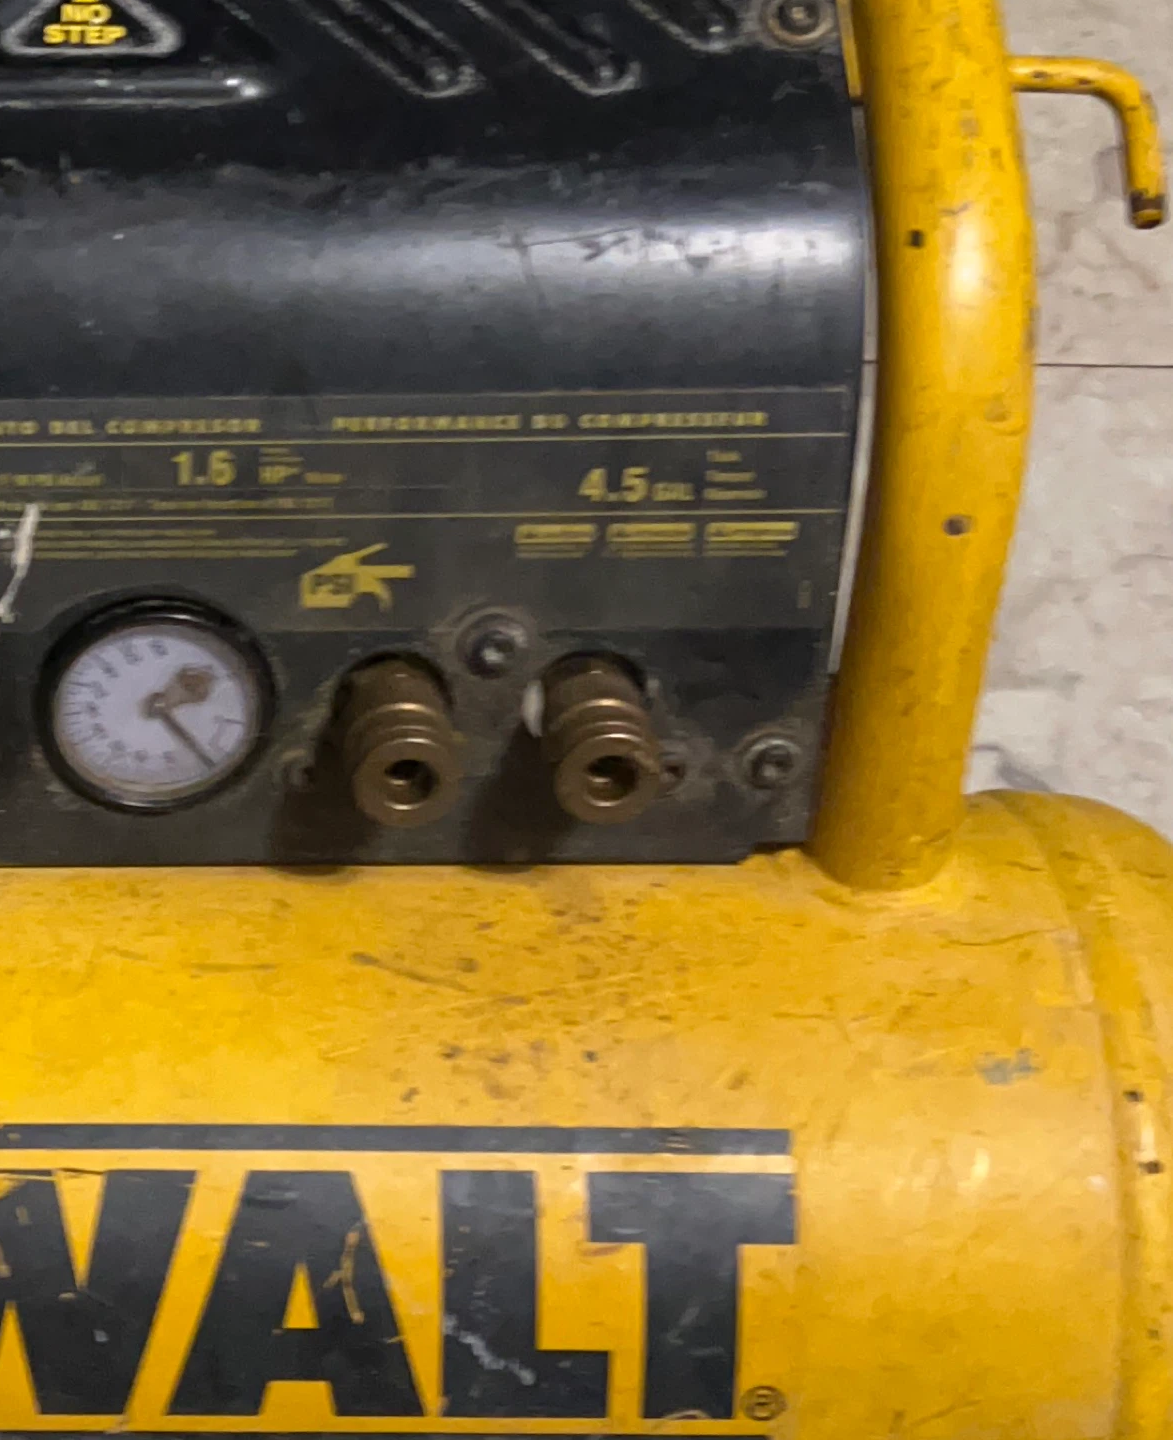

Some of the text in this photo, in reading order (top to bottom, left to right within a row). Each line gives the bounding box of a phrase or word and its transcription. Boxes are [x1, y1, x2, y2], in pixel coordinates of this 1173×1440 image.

[60, 3, 112, 24] NO
[43, 24, 127, 45] STEP
[332, 415, 522, 432] PERFORMANCE
[170, 449, 237, 486] 1.6
[578, 466, 650, 503] 4.5
[310, 573, 356, 595] PSI
